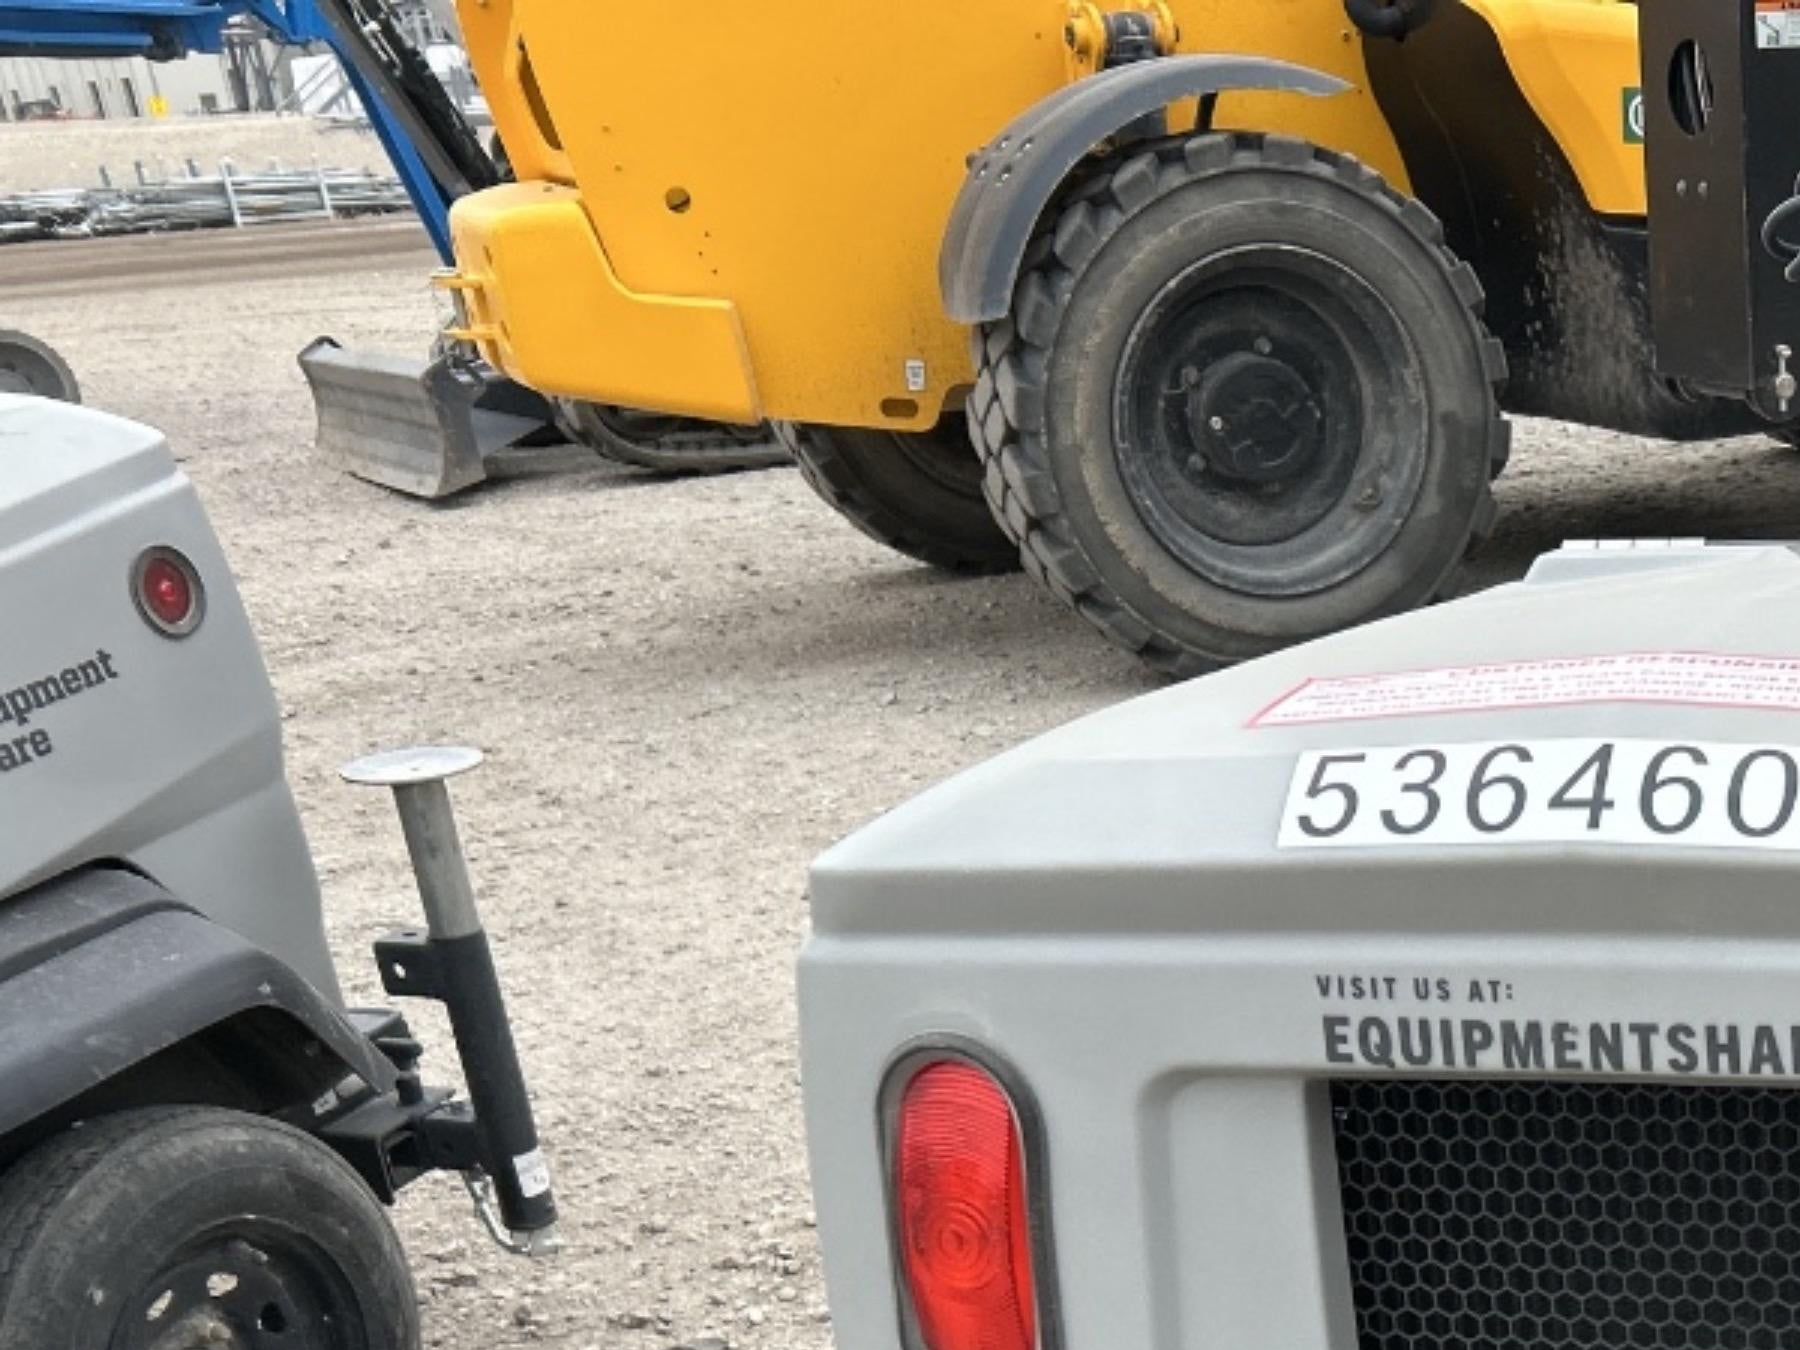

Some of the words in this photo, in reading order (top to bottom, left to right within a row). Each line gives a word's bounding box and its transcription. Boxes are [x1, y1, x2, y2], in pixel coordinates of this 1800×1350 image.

[1297, 741, 1800, 839] 536460
[1316, 974, 1398, 1001] VISIT
[1413, 977, 1452, 1003] US
[1467, 979, 1514, 1004] AT:
